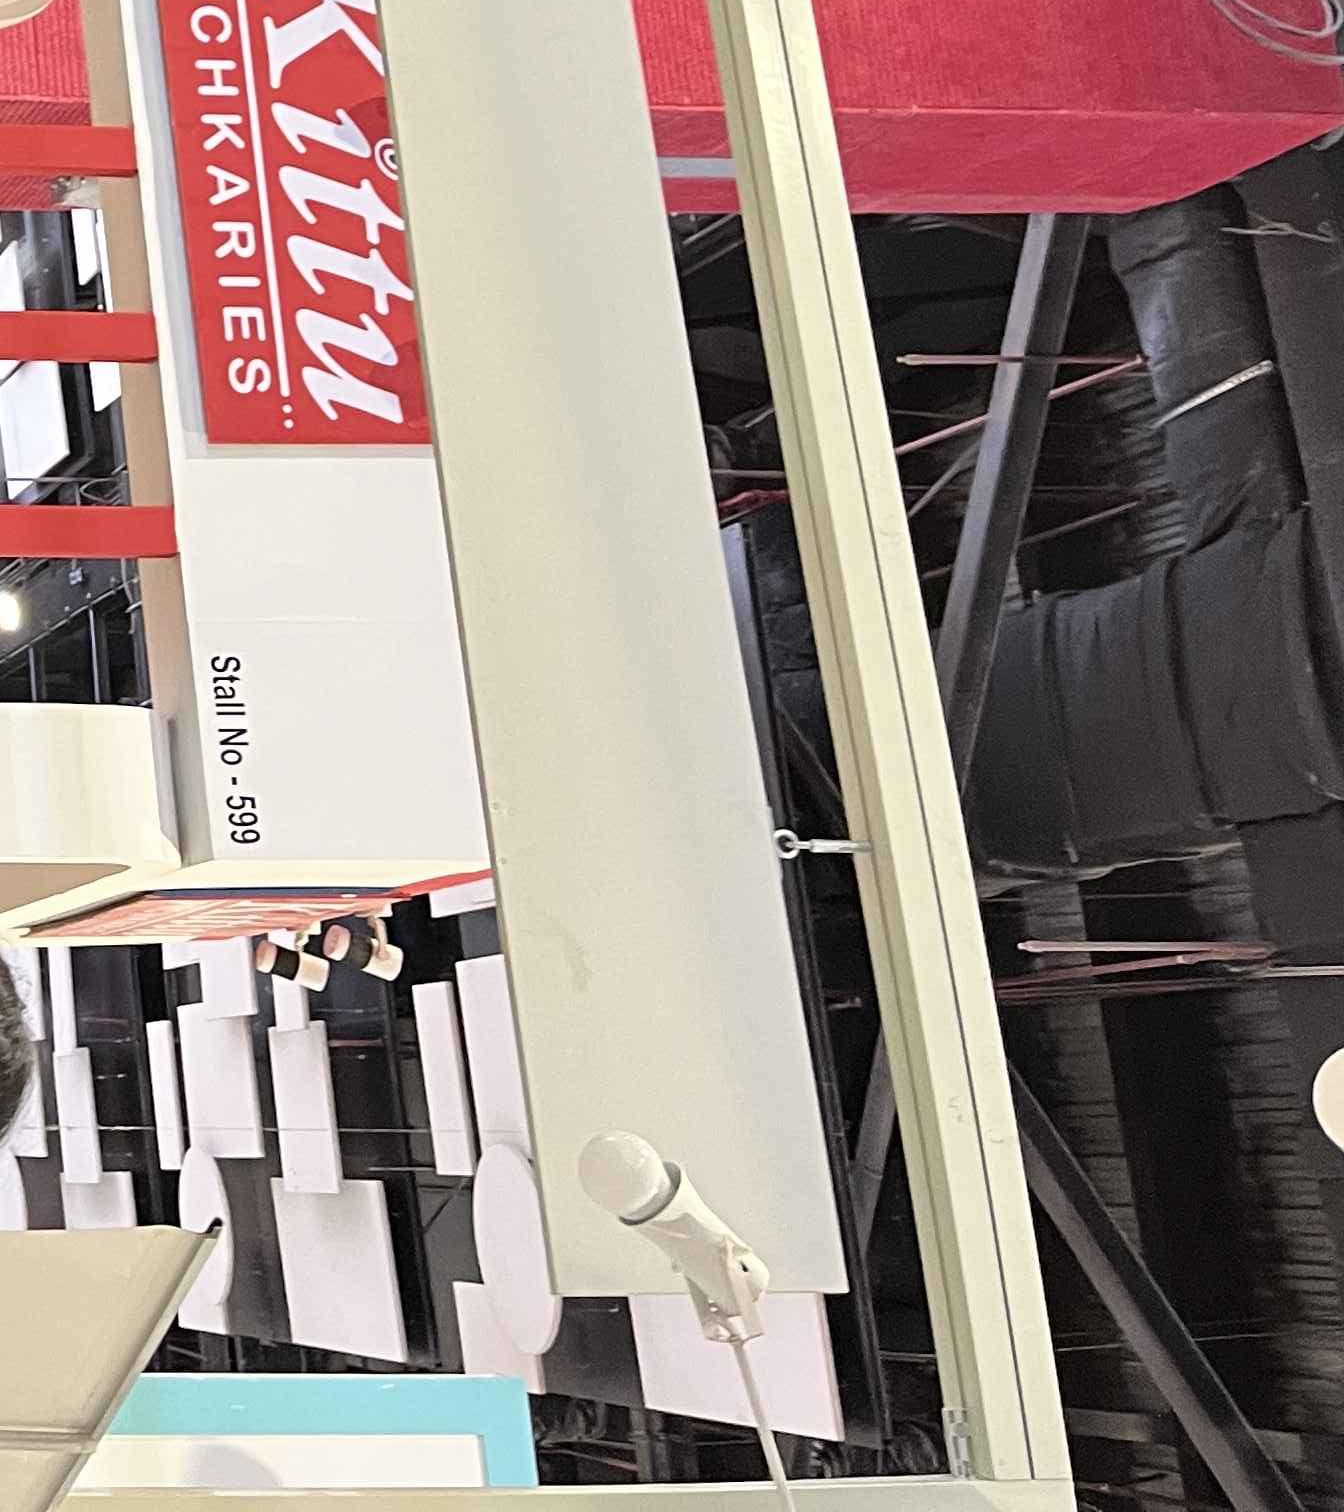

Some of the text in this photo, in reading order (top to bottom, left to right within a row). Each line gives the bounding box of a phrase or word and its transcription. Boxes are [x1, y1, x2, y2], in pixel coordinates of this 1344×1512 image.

[209, 655, 245, 717] Stall
[218, 727, 251, 765] No
[225, 795, 260, 845] 599
